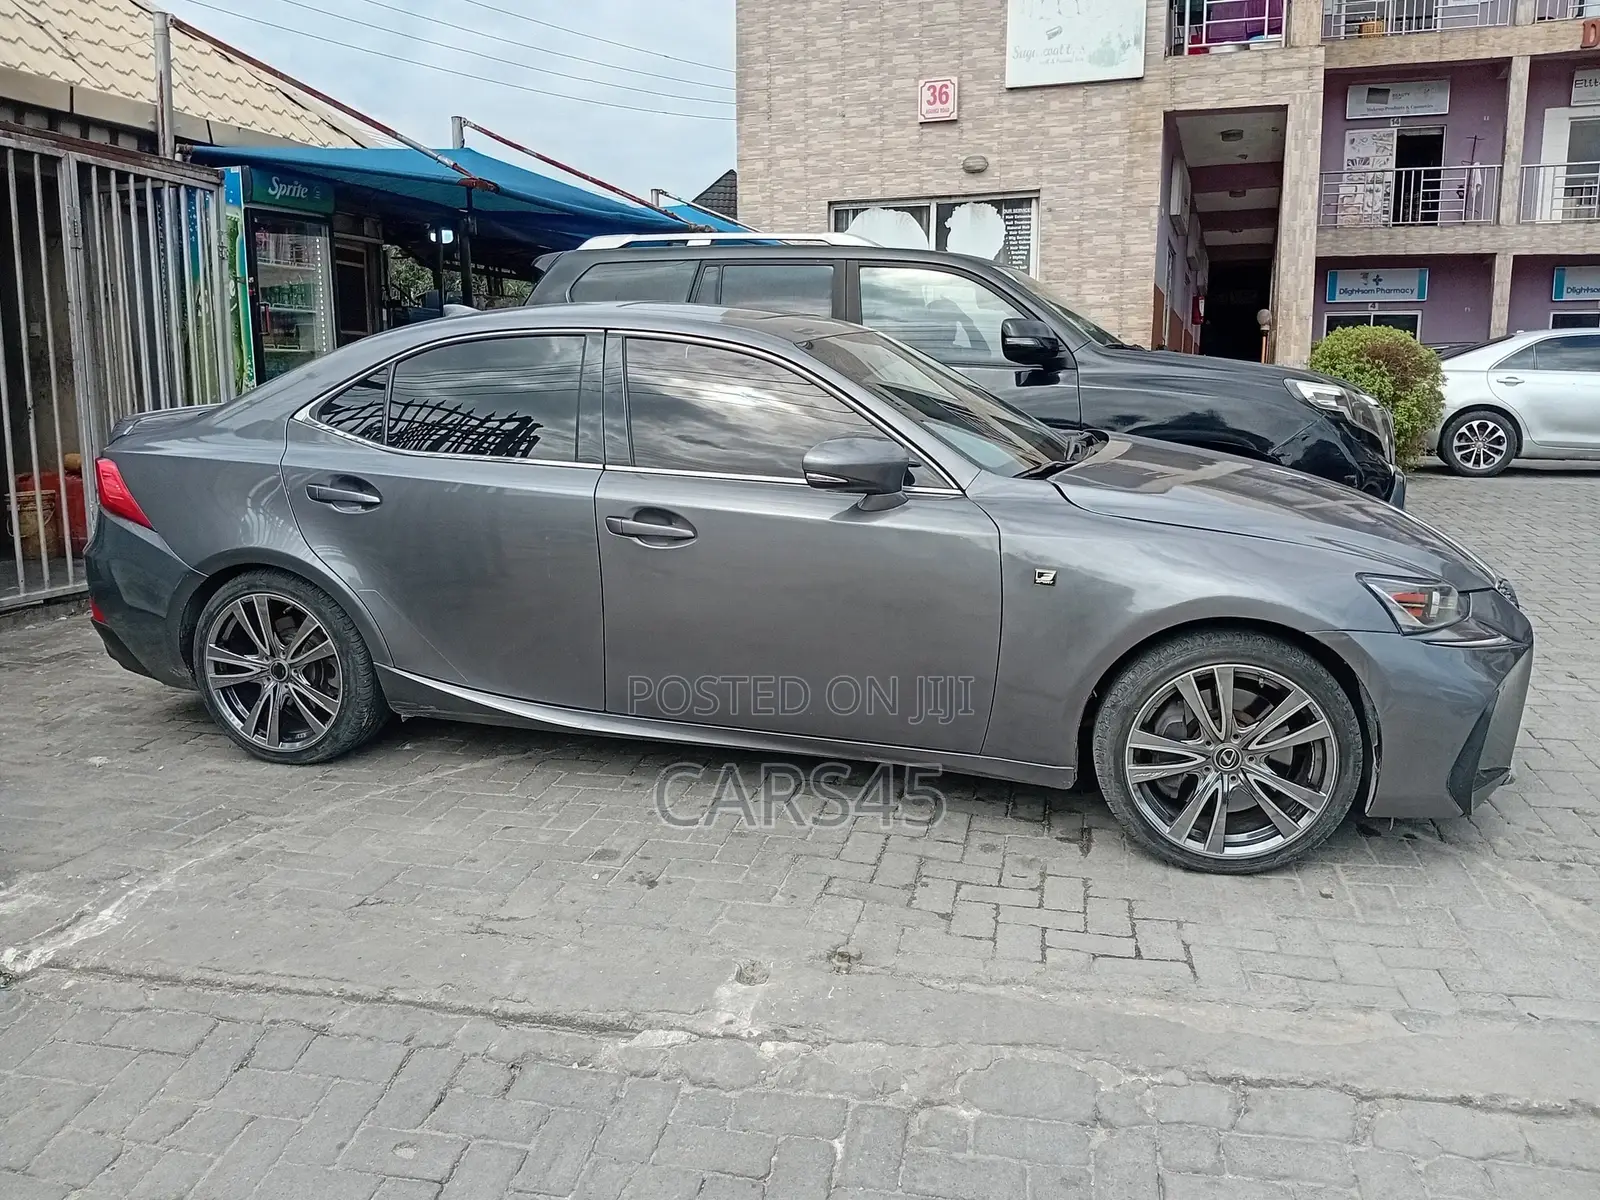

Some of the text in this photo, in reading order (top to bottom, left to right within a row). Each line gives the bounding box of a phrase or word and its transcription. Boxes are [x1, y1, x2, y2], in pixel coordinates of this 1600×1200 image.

[1574, 78, 1600, 89] Elit
[926, 84, 950, 106] 36
[267, 176, 309, 200] Sprite
[1376, 287, 1415, 296] Pharmacy
